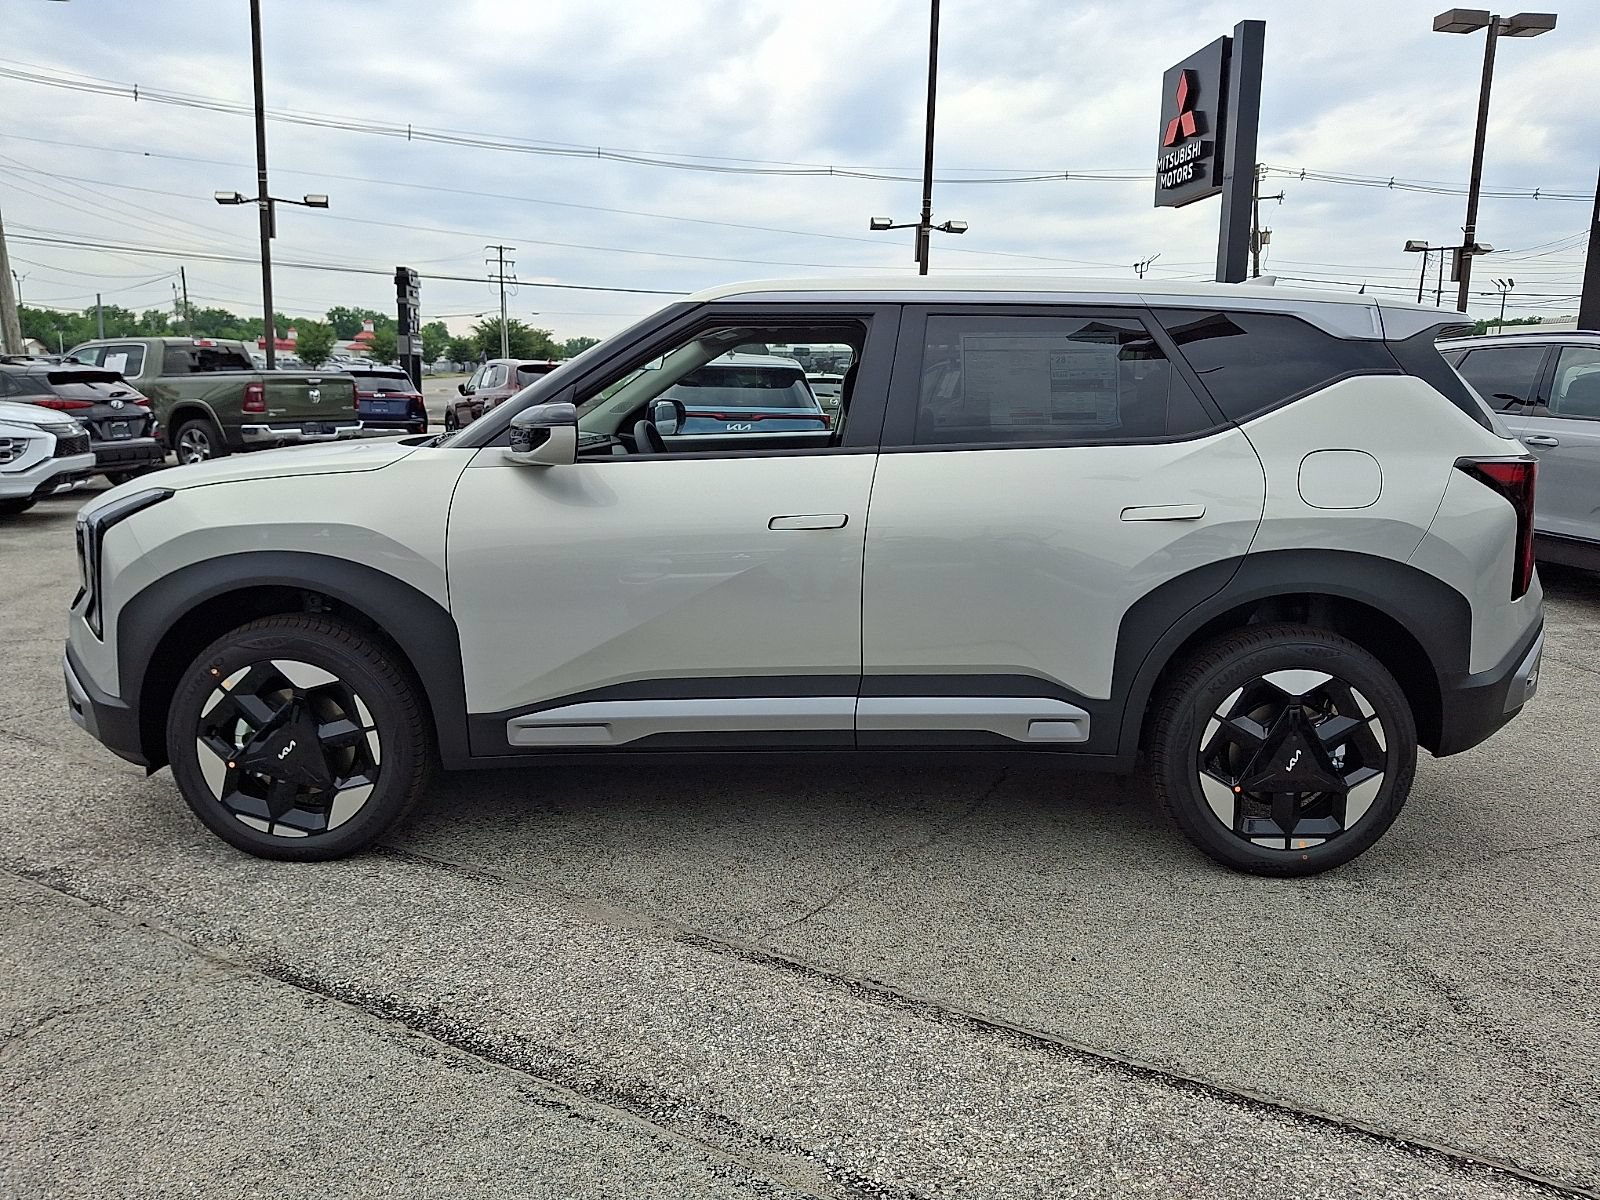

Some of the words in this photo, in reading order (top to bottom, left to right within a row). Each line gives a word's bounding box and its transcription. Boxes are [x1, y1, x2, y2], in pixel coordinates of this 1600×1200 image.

[1157, 140, 1201, 171] MITSUBISHI
[1160, 163, 1193, 188] MOTORS
[726, 423, 752, 432] KIA
[278, 740, 297, 760] KIA
[1285, 749, 1302, 772] KIA
